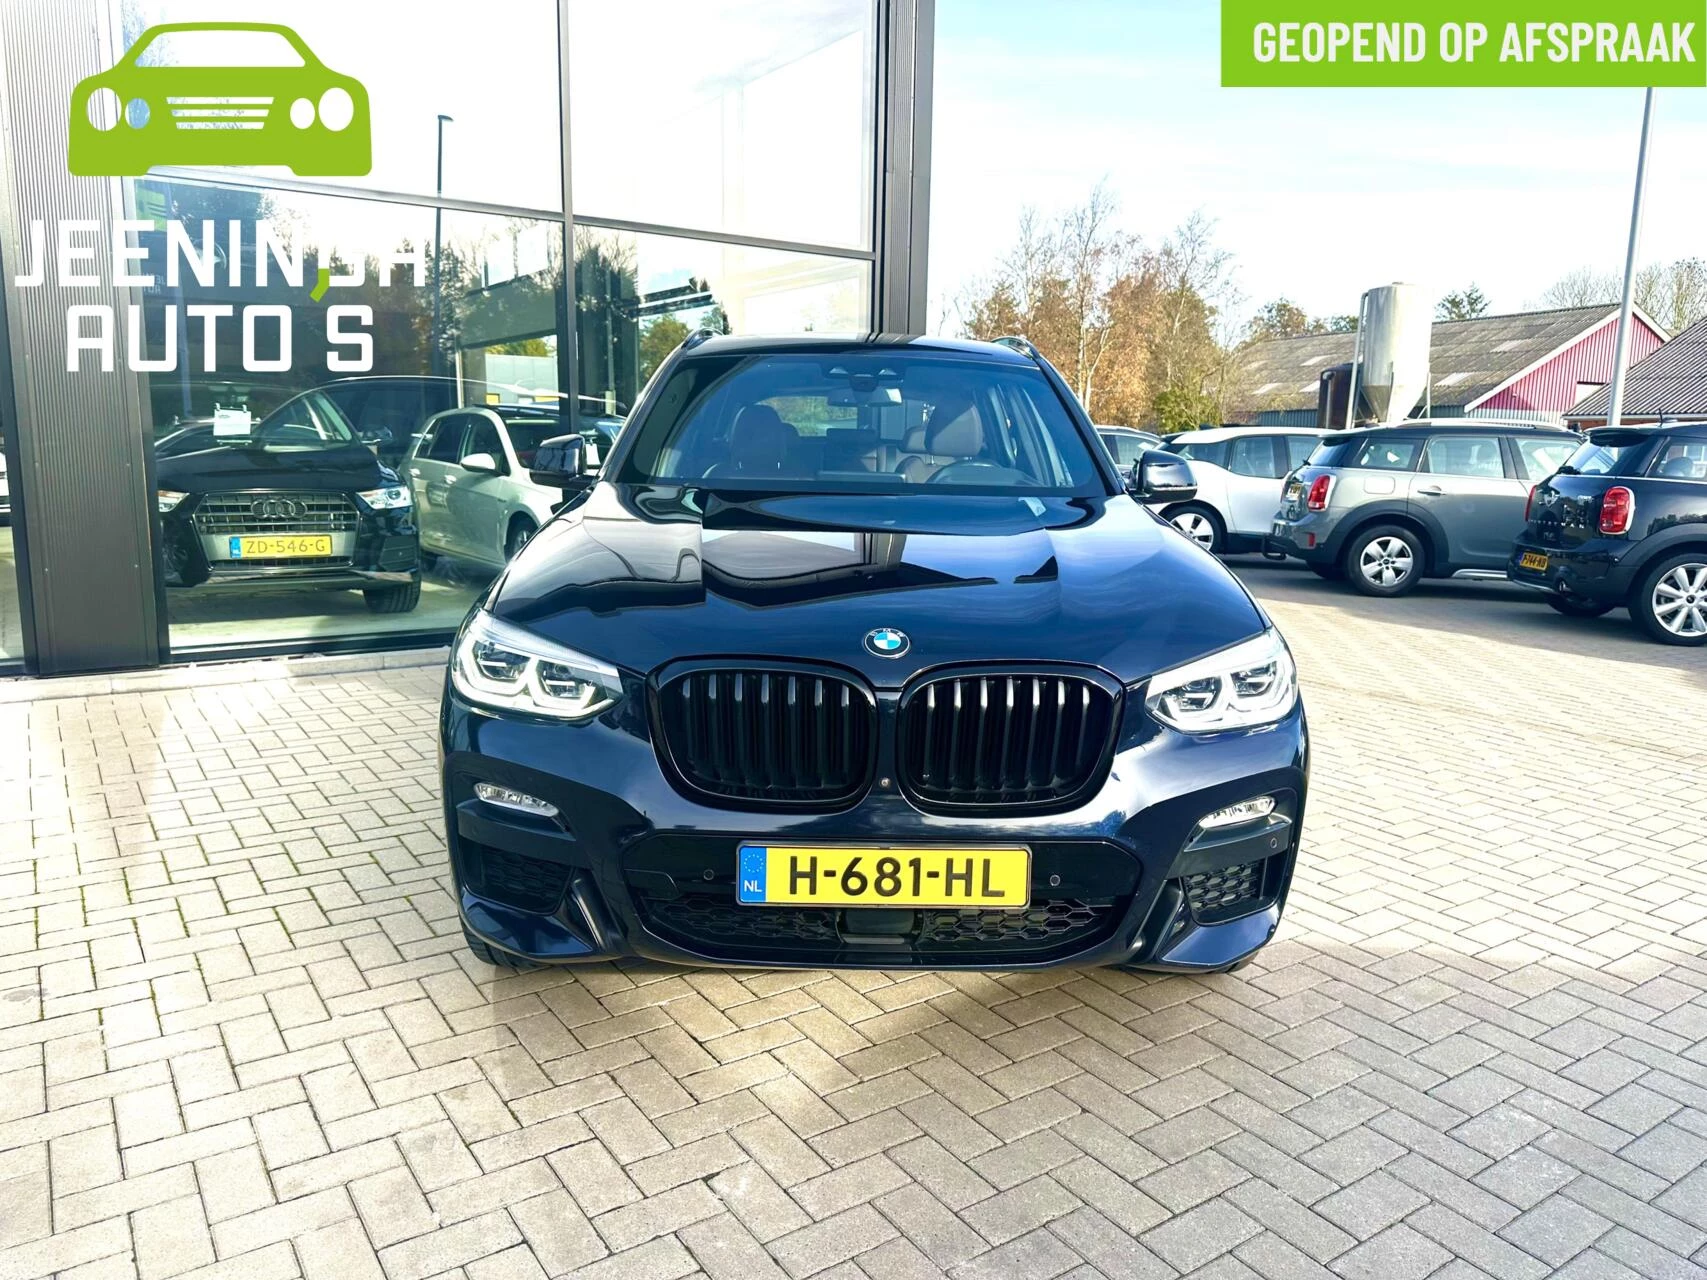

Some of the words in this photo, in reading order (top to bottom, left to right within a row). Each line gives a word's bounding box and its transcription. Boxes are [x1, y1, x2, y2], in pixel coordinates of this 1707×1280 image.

[246, 539, 325, 554] ZD-546-G
[788, 855, 1006, 898] H-681-HL
[743, 881, 763, 893] NL
